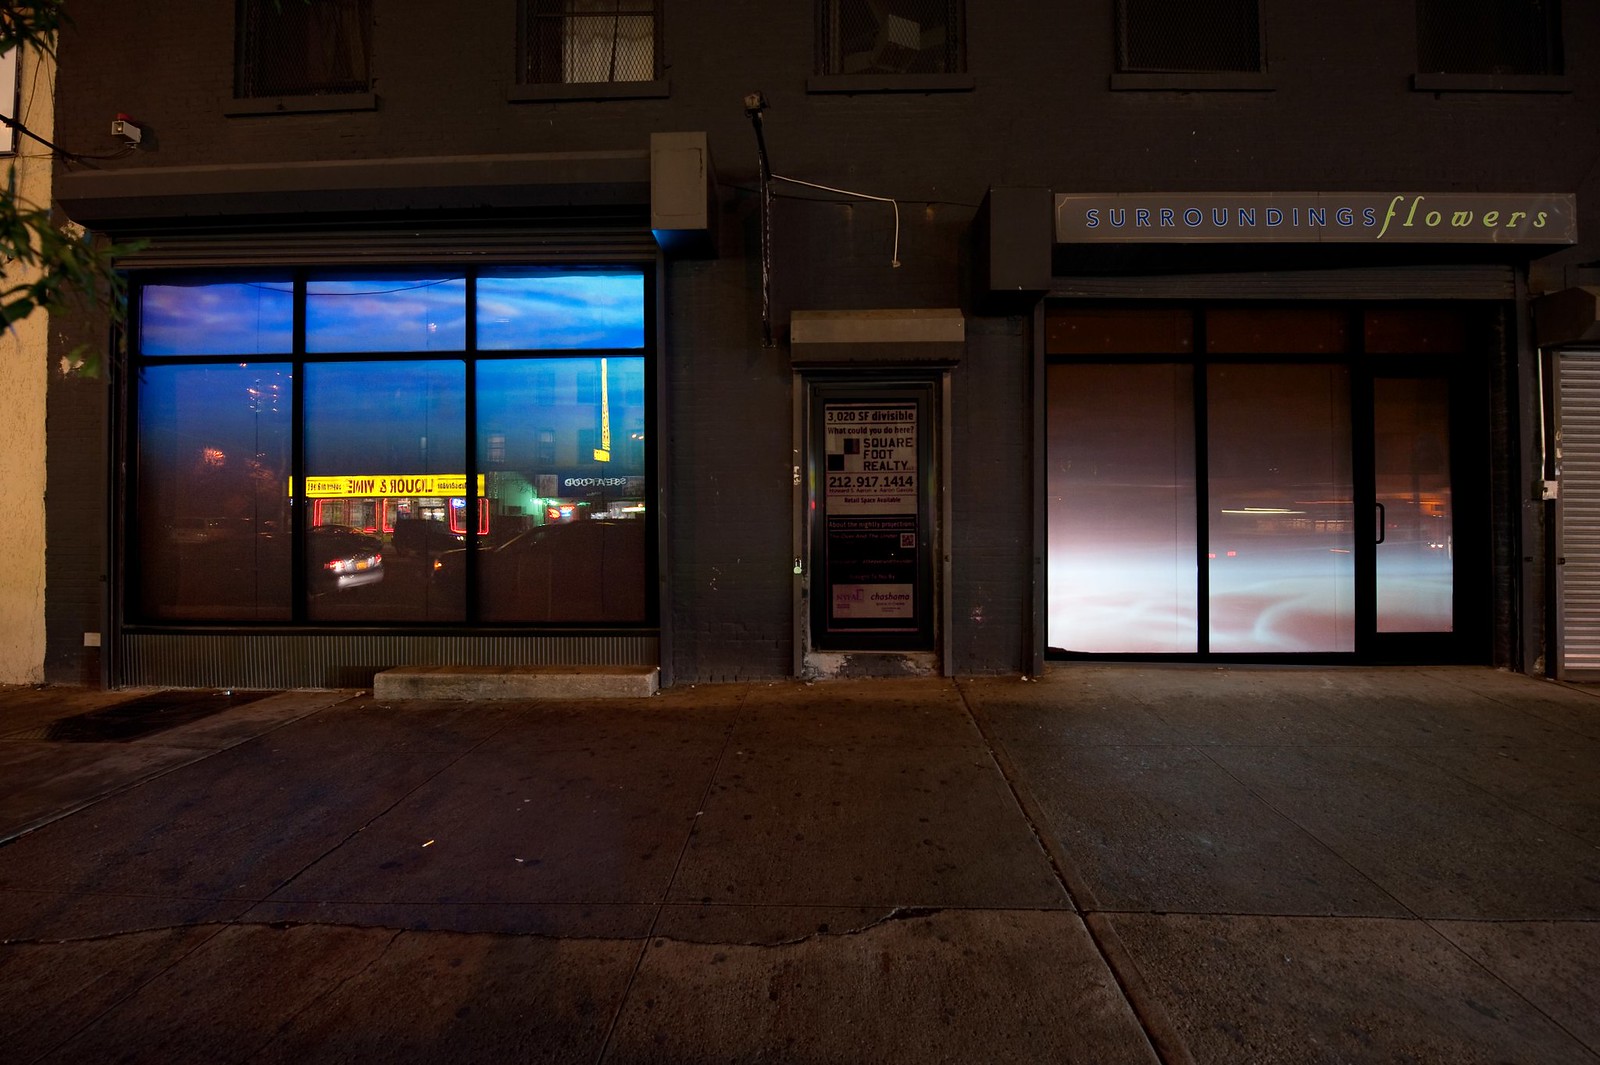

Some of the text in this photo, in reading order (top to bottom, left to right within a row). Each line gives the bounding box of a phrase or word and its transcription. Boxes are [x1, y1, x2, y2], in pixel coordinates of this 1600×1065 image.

[1086, 195, 1548, 239] SURROUNDINGS flowers
[828, 411, 913, 422] 3,020 SF divisible
[828, 425, 914, 436] What could you do here?
[863, 438, 913, 448] SQUARE
[863, 449, 894, 460] FOOT
[863, 461, 908, 471] REALTY
[829, 476, 914, 488] 212.917.1414
